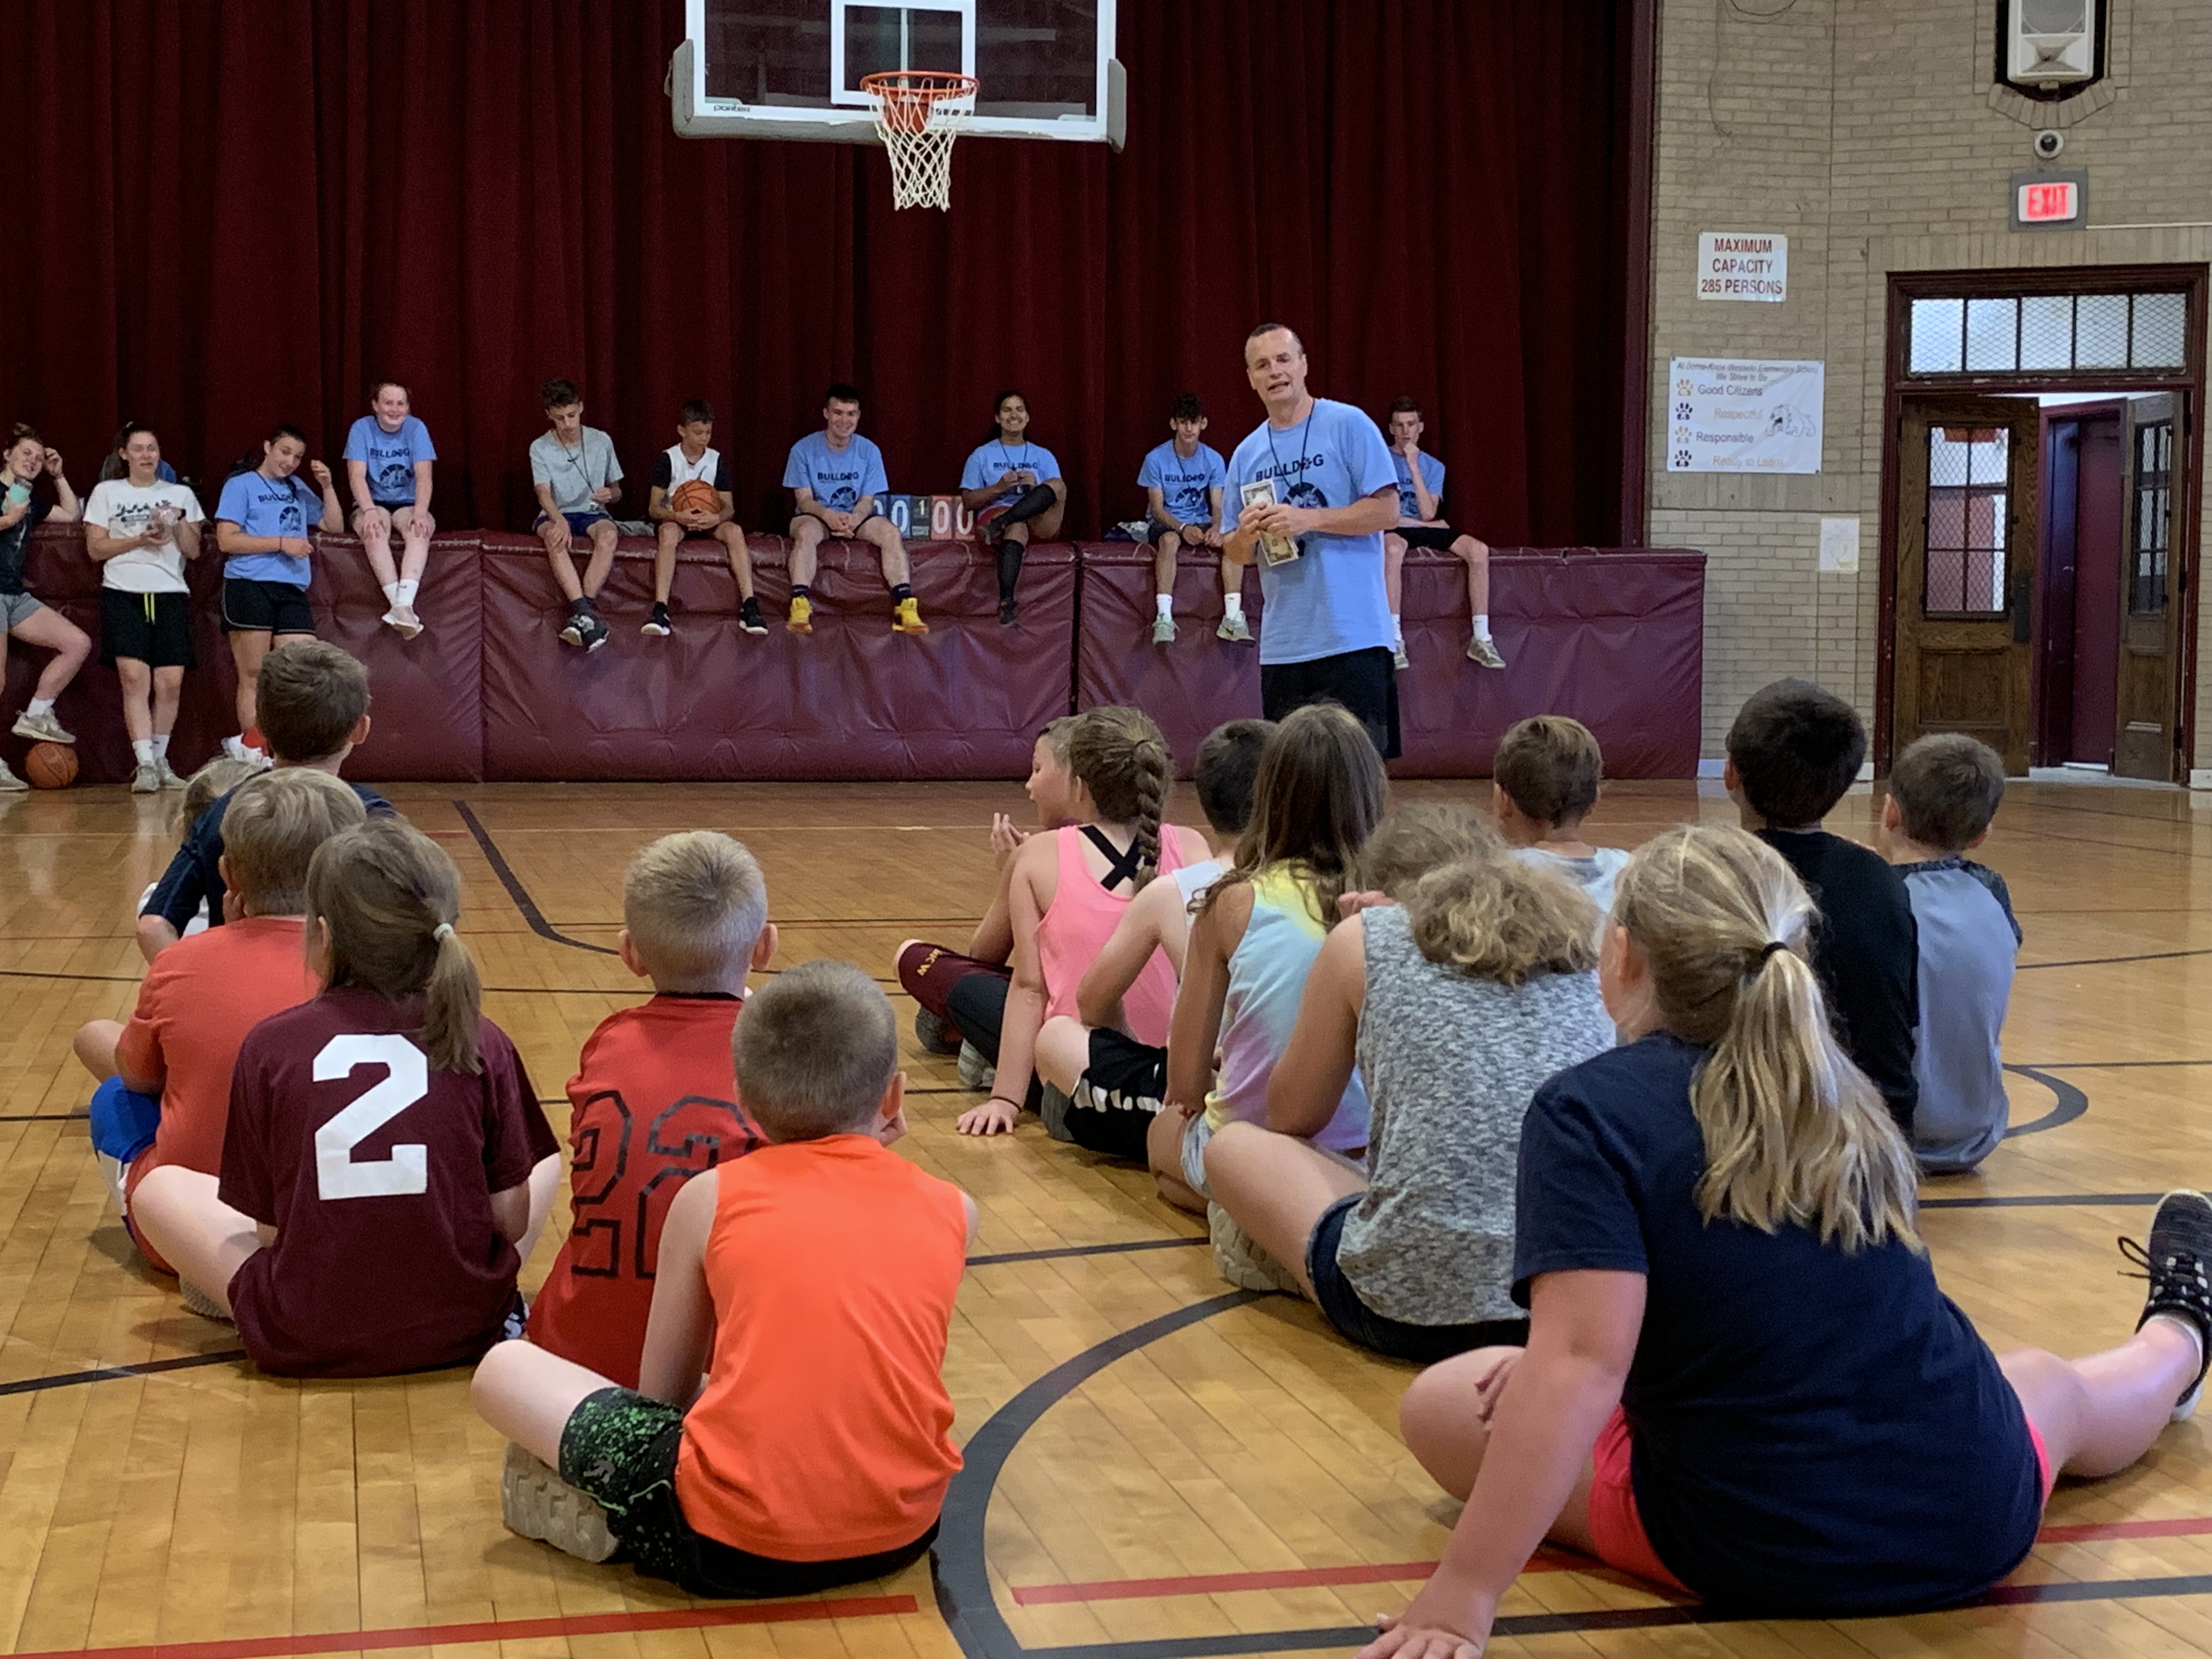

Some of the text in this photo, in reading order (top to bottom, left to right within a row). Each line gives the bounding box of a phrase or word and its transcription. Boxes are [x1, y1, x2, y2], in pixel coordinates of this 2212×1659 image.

[2028, 185, 2069, 218] EXIT
[1714, 238, 1773, 253] MAXIMUM
[1713, 258, 1773, 273] CAPACITY
[1702, 279, 1782, 294] 285 PERSONS
[1698, 384, 1763, 396] Good Citizens
[1714, 407, 1763, 420] Respectful
[1696, 431, 1754, 444] Responsible
[1713, 456, 1783, 469] Ready to Learn
[919, 499, 925, 516] 1
[313, 1035, 428, 1200] 2
